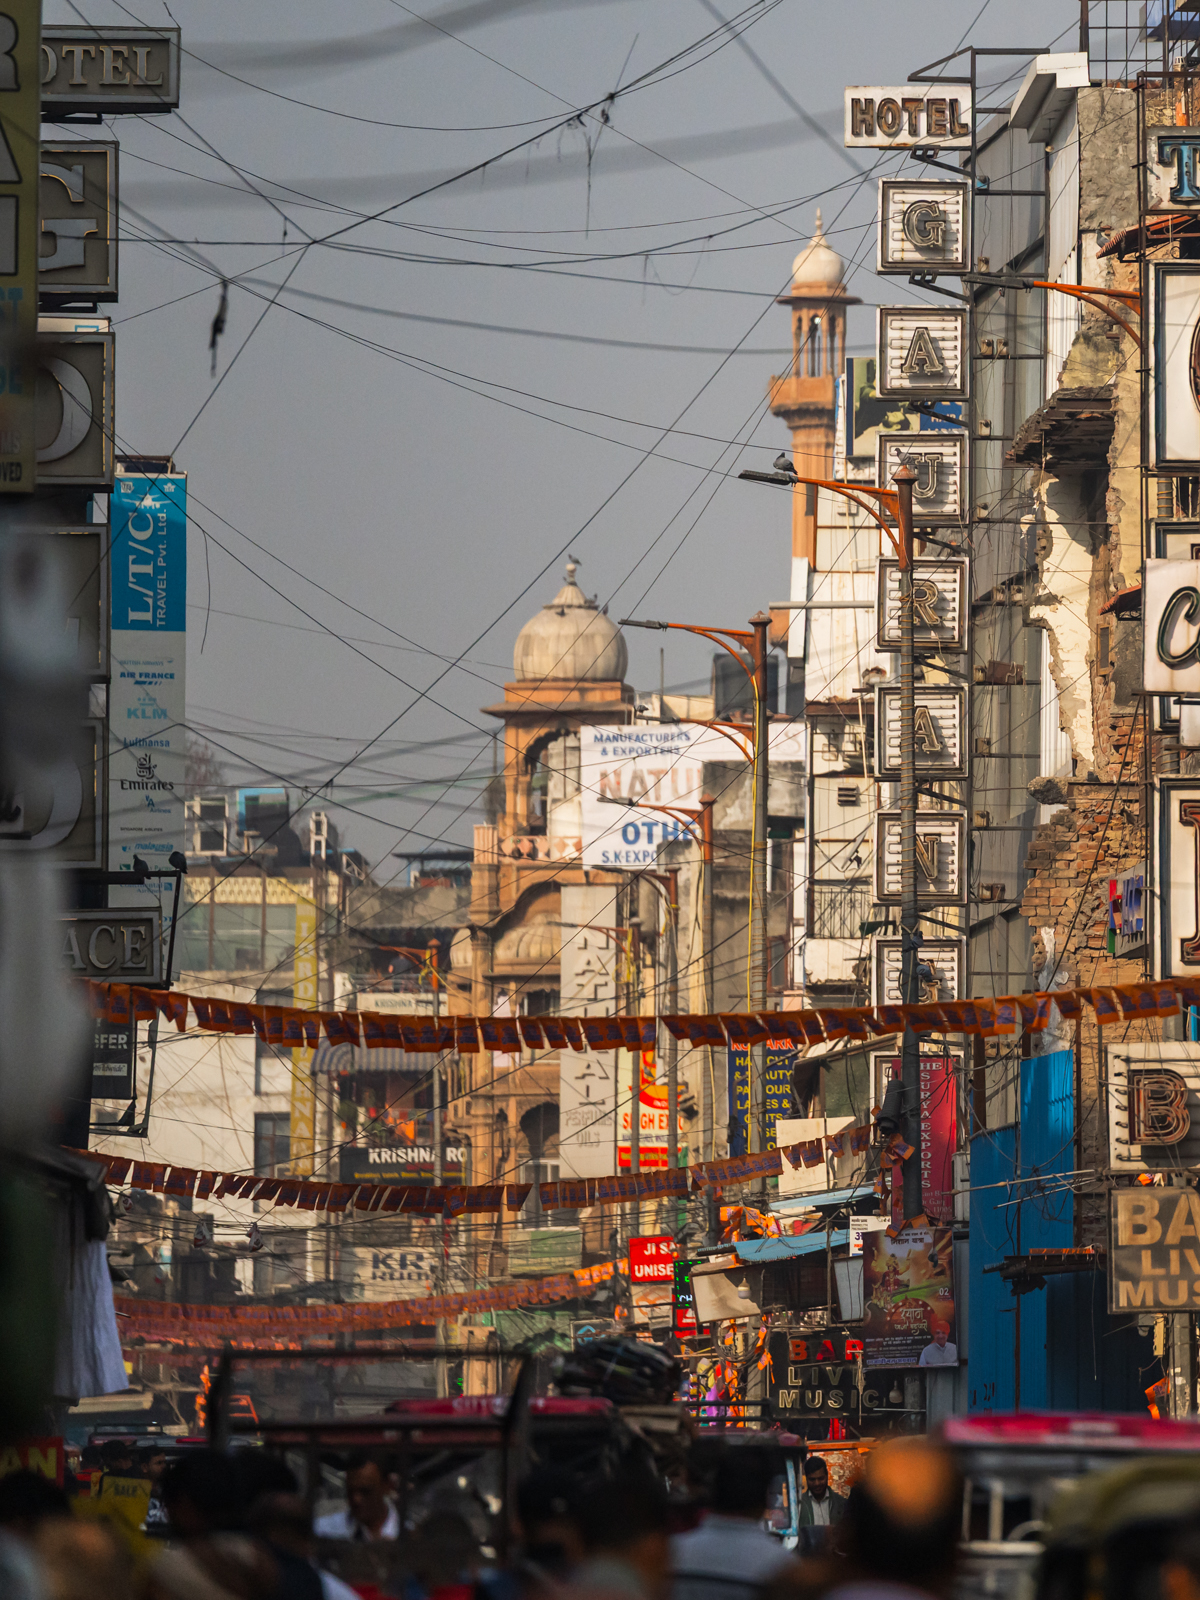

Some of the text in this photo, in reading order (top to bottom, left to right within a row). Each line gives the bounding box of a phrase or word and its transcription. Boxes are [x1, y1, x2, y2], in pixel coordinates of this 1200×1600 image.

[851, 97, 969, 137] HOTEL
[157, 508, 167, 628] TRAVEL Pvt. Ltd.
[139, 672, 175, 680] FRANCE
[126, 708, 168, 720] KLM
[123, 737, 170, 748] Lufthansa
[594, 732, 691, 744] MANUFACTURERS
[120, 779, 174, 791] Emirates
[600, 768, 700, 803] NATU
[920, 1122, 932, 1189] EXPORTS
[788, 1339, 864, 1361] BAR
[779, 1389, 880, 1409] MUSIC
